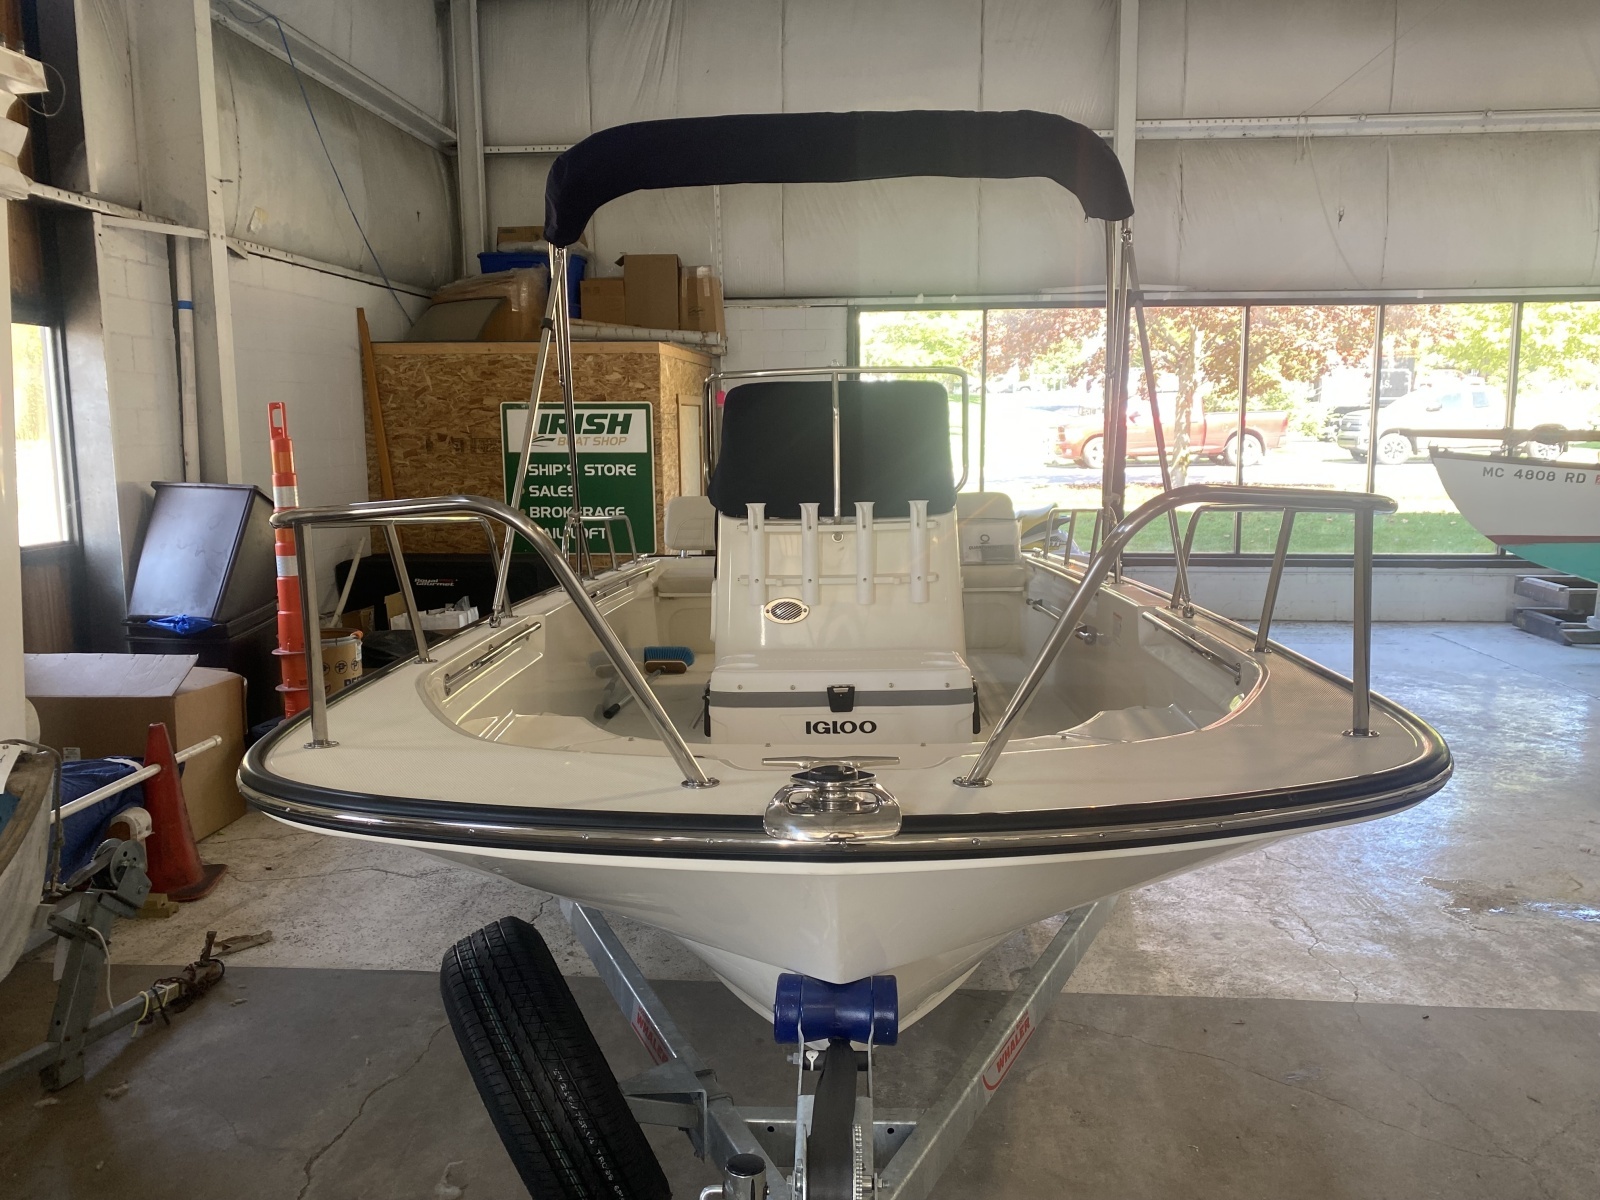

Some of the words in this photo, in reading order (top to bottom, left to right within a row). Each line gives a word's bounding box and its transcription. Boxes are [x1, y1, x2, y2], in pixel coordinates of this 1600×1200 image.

[538, 413, 632, 435] IRISH
[557, 436, 590, 446] BAT
[592, 436, 628, 446] SHOP
[584, 463, 637, 476] STORE
[1482, 466, 1505, 478] MC
[1513, 468, 1556, 482] 4808
[1564, 472, 1587, 484] RD
[805, 720, 877, 735] IGLOO
[996, 1017, 1031, 1073] WHALER
